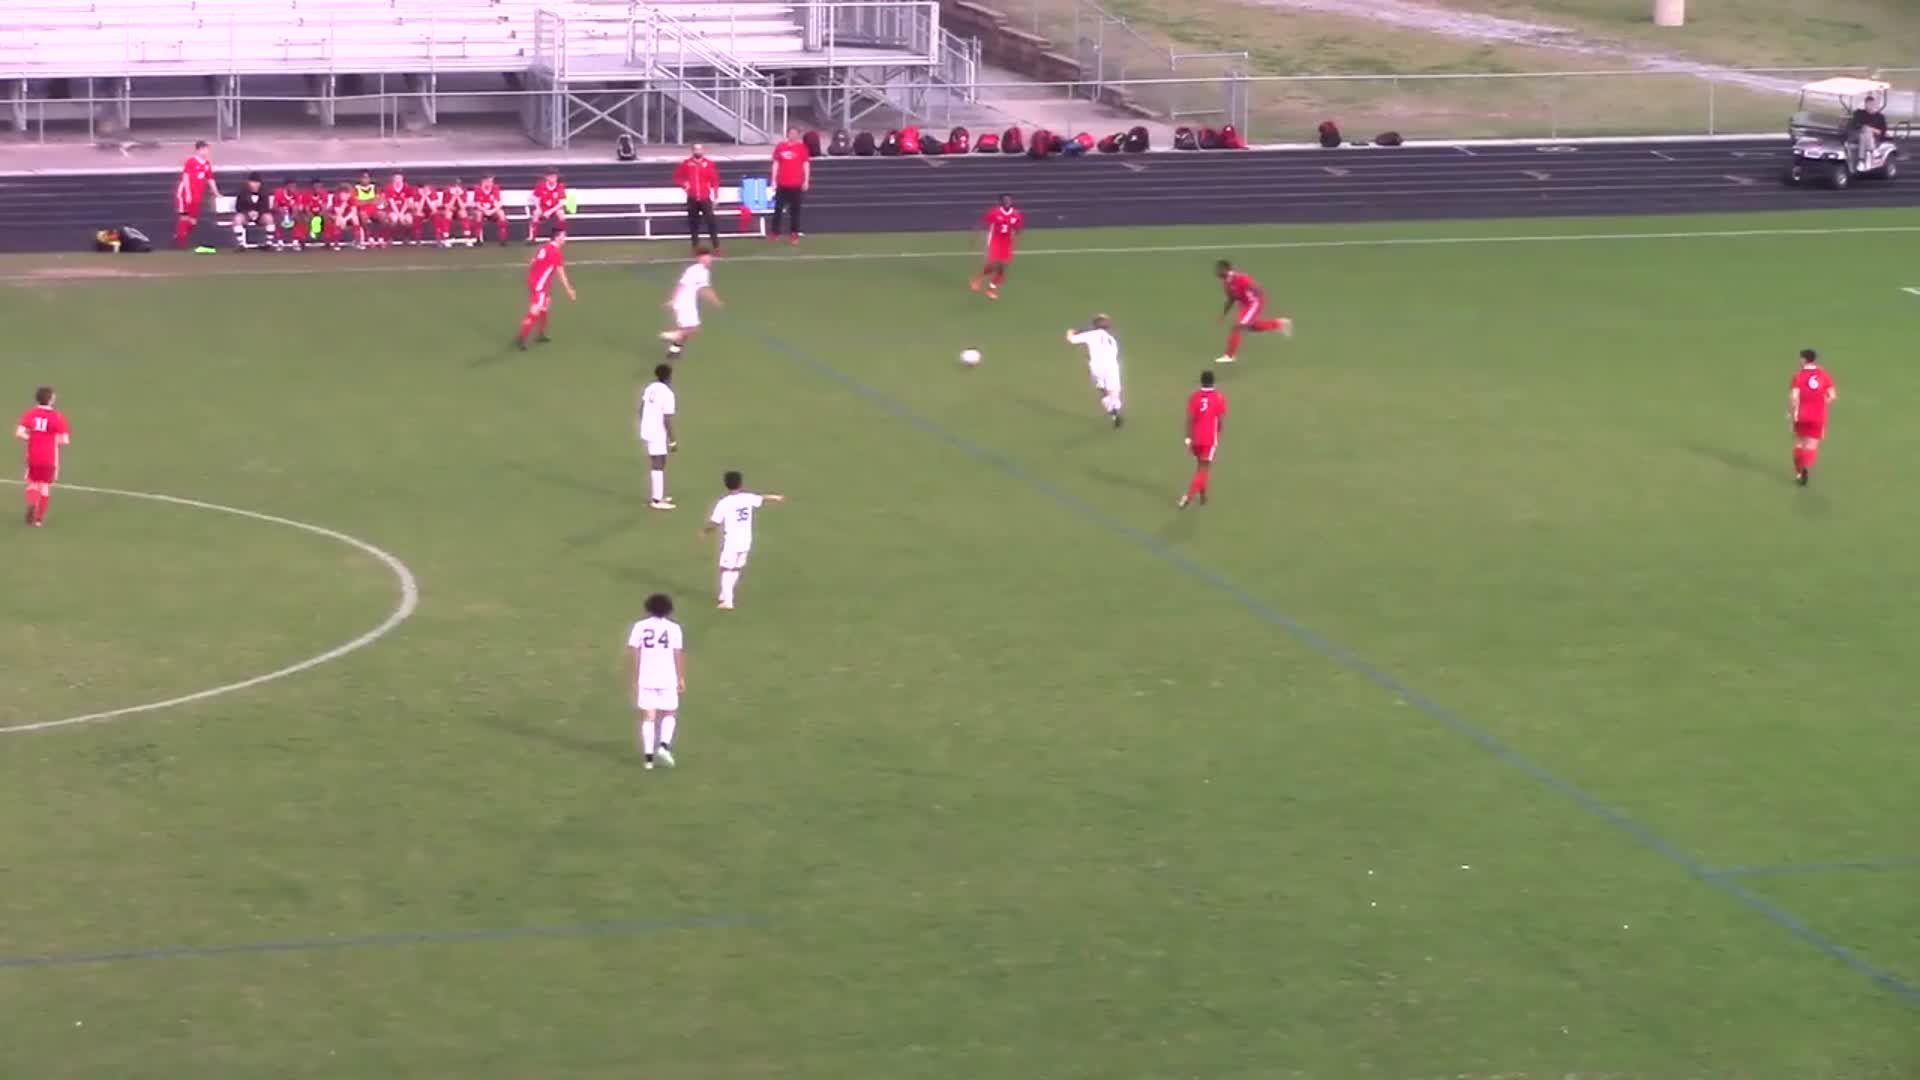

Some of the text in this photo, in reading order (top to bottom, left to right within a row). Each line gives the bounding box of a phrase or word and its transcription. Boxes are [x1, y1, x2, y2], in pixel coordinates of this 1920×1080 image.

[1808, 375, 1819, 389] 6
[1199, 398, 1208, 411] 3
[34, 417, 48, 431] 11
[643, 629, 669, 649] 24
